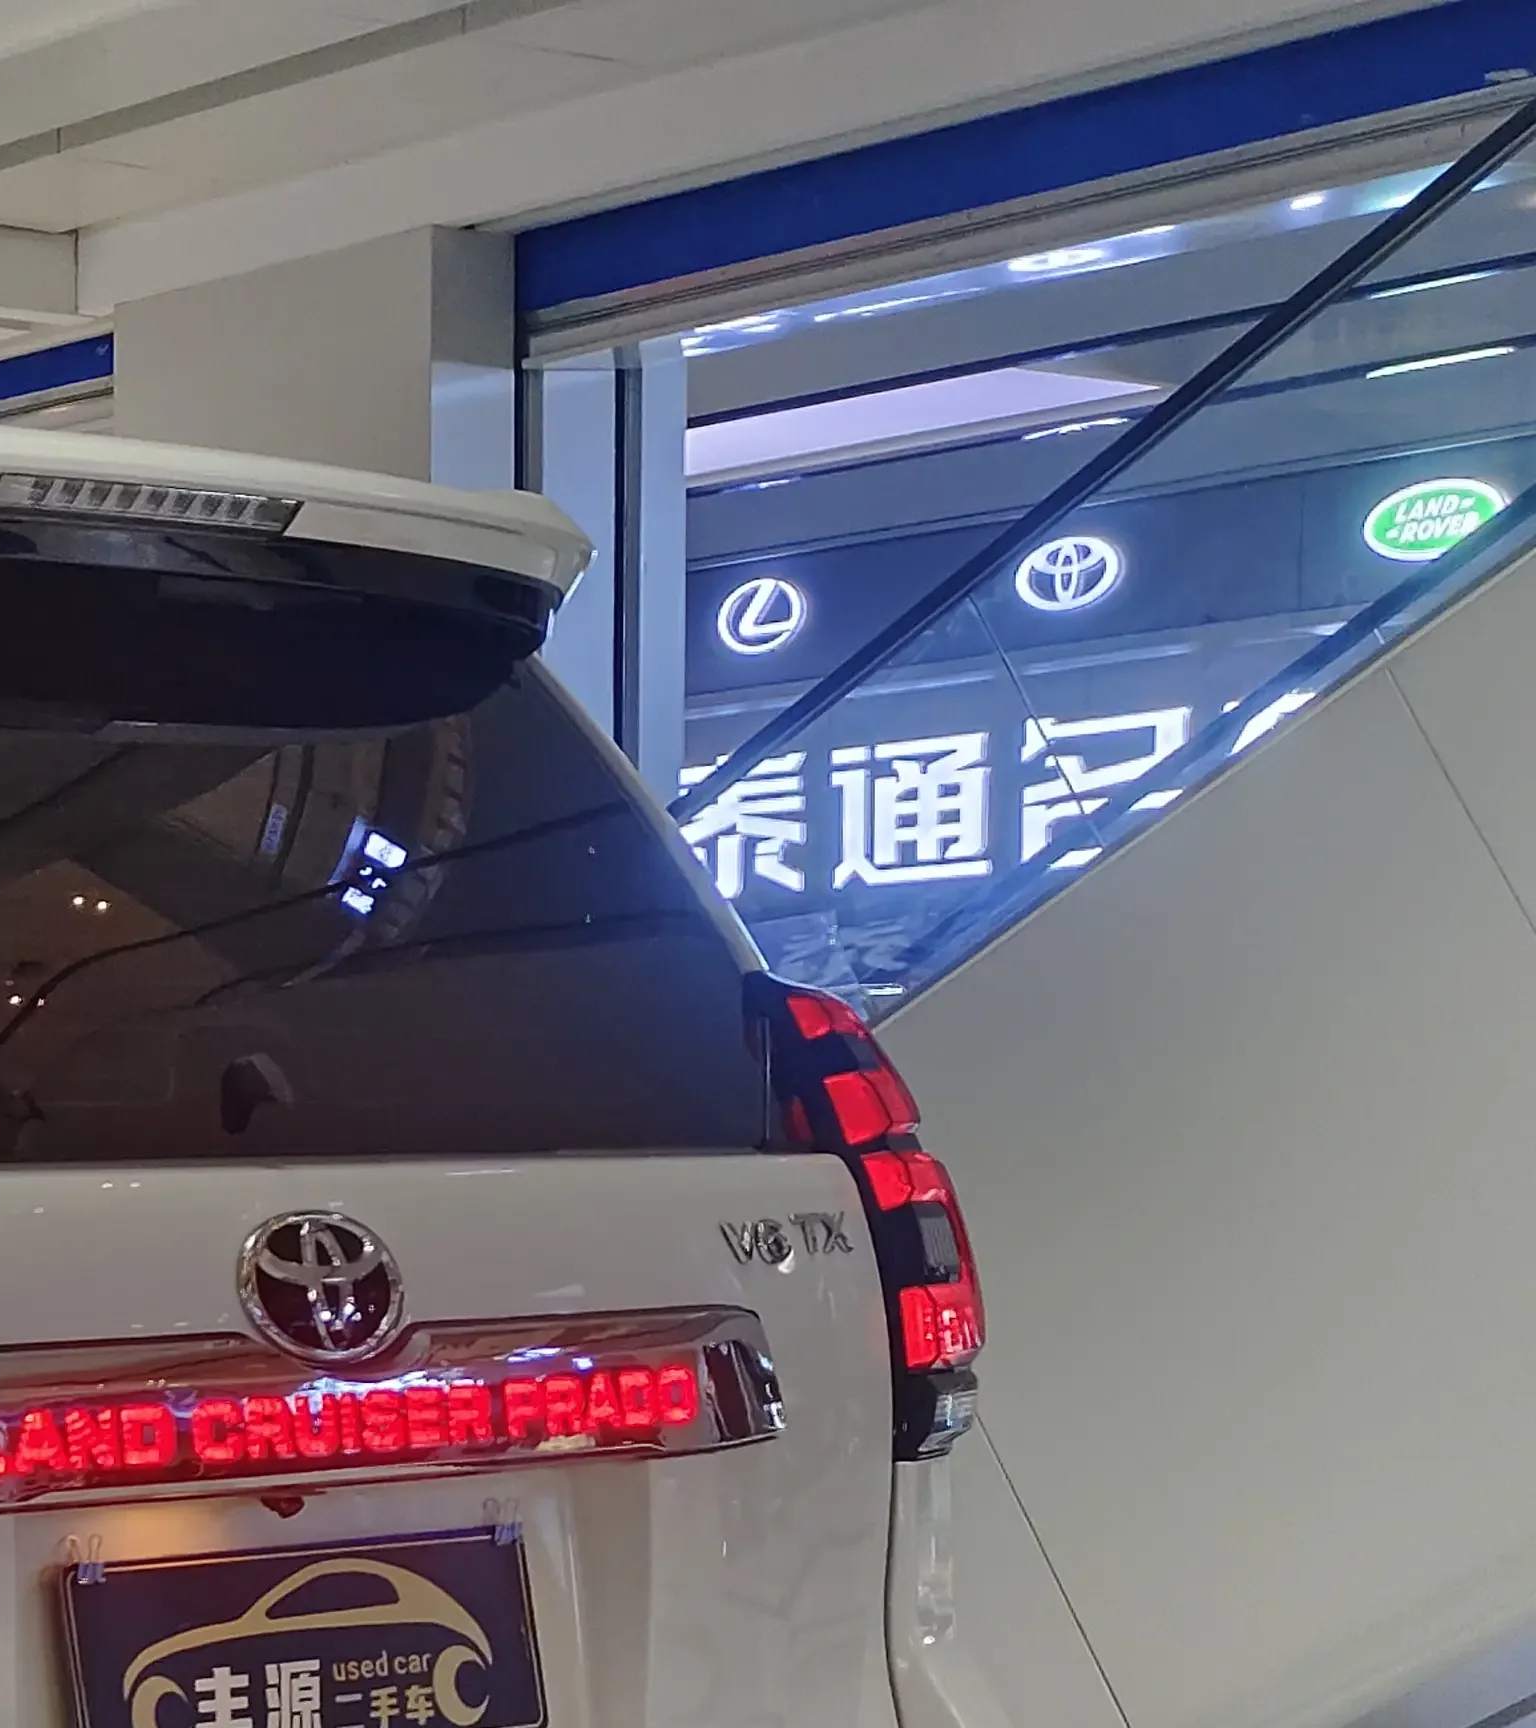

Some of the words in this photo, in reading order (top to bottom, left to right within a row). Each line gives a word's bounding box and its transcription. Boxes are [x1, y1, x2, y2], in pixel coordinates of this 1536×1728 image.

[678, 690, 1316, 898] 泰通名
[191, 1380, 493, 1464] CRUISER
[503, 1364, 700, 1438] PRADO
[332, 1651, 389, 1683] used
[393, 1651, 433, 1677] car
